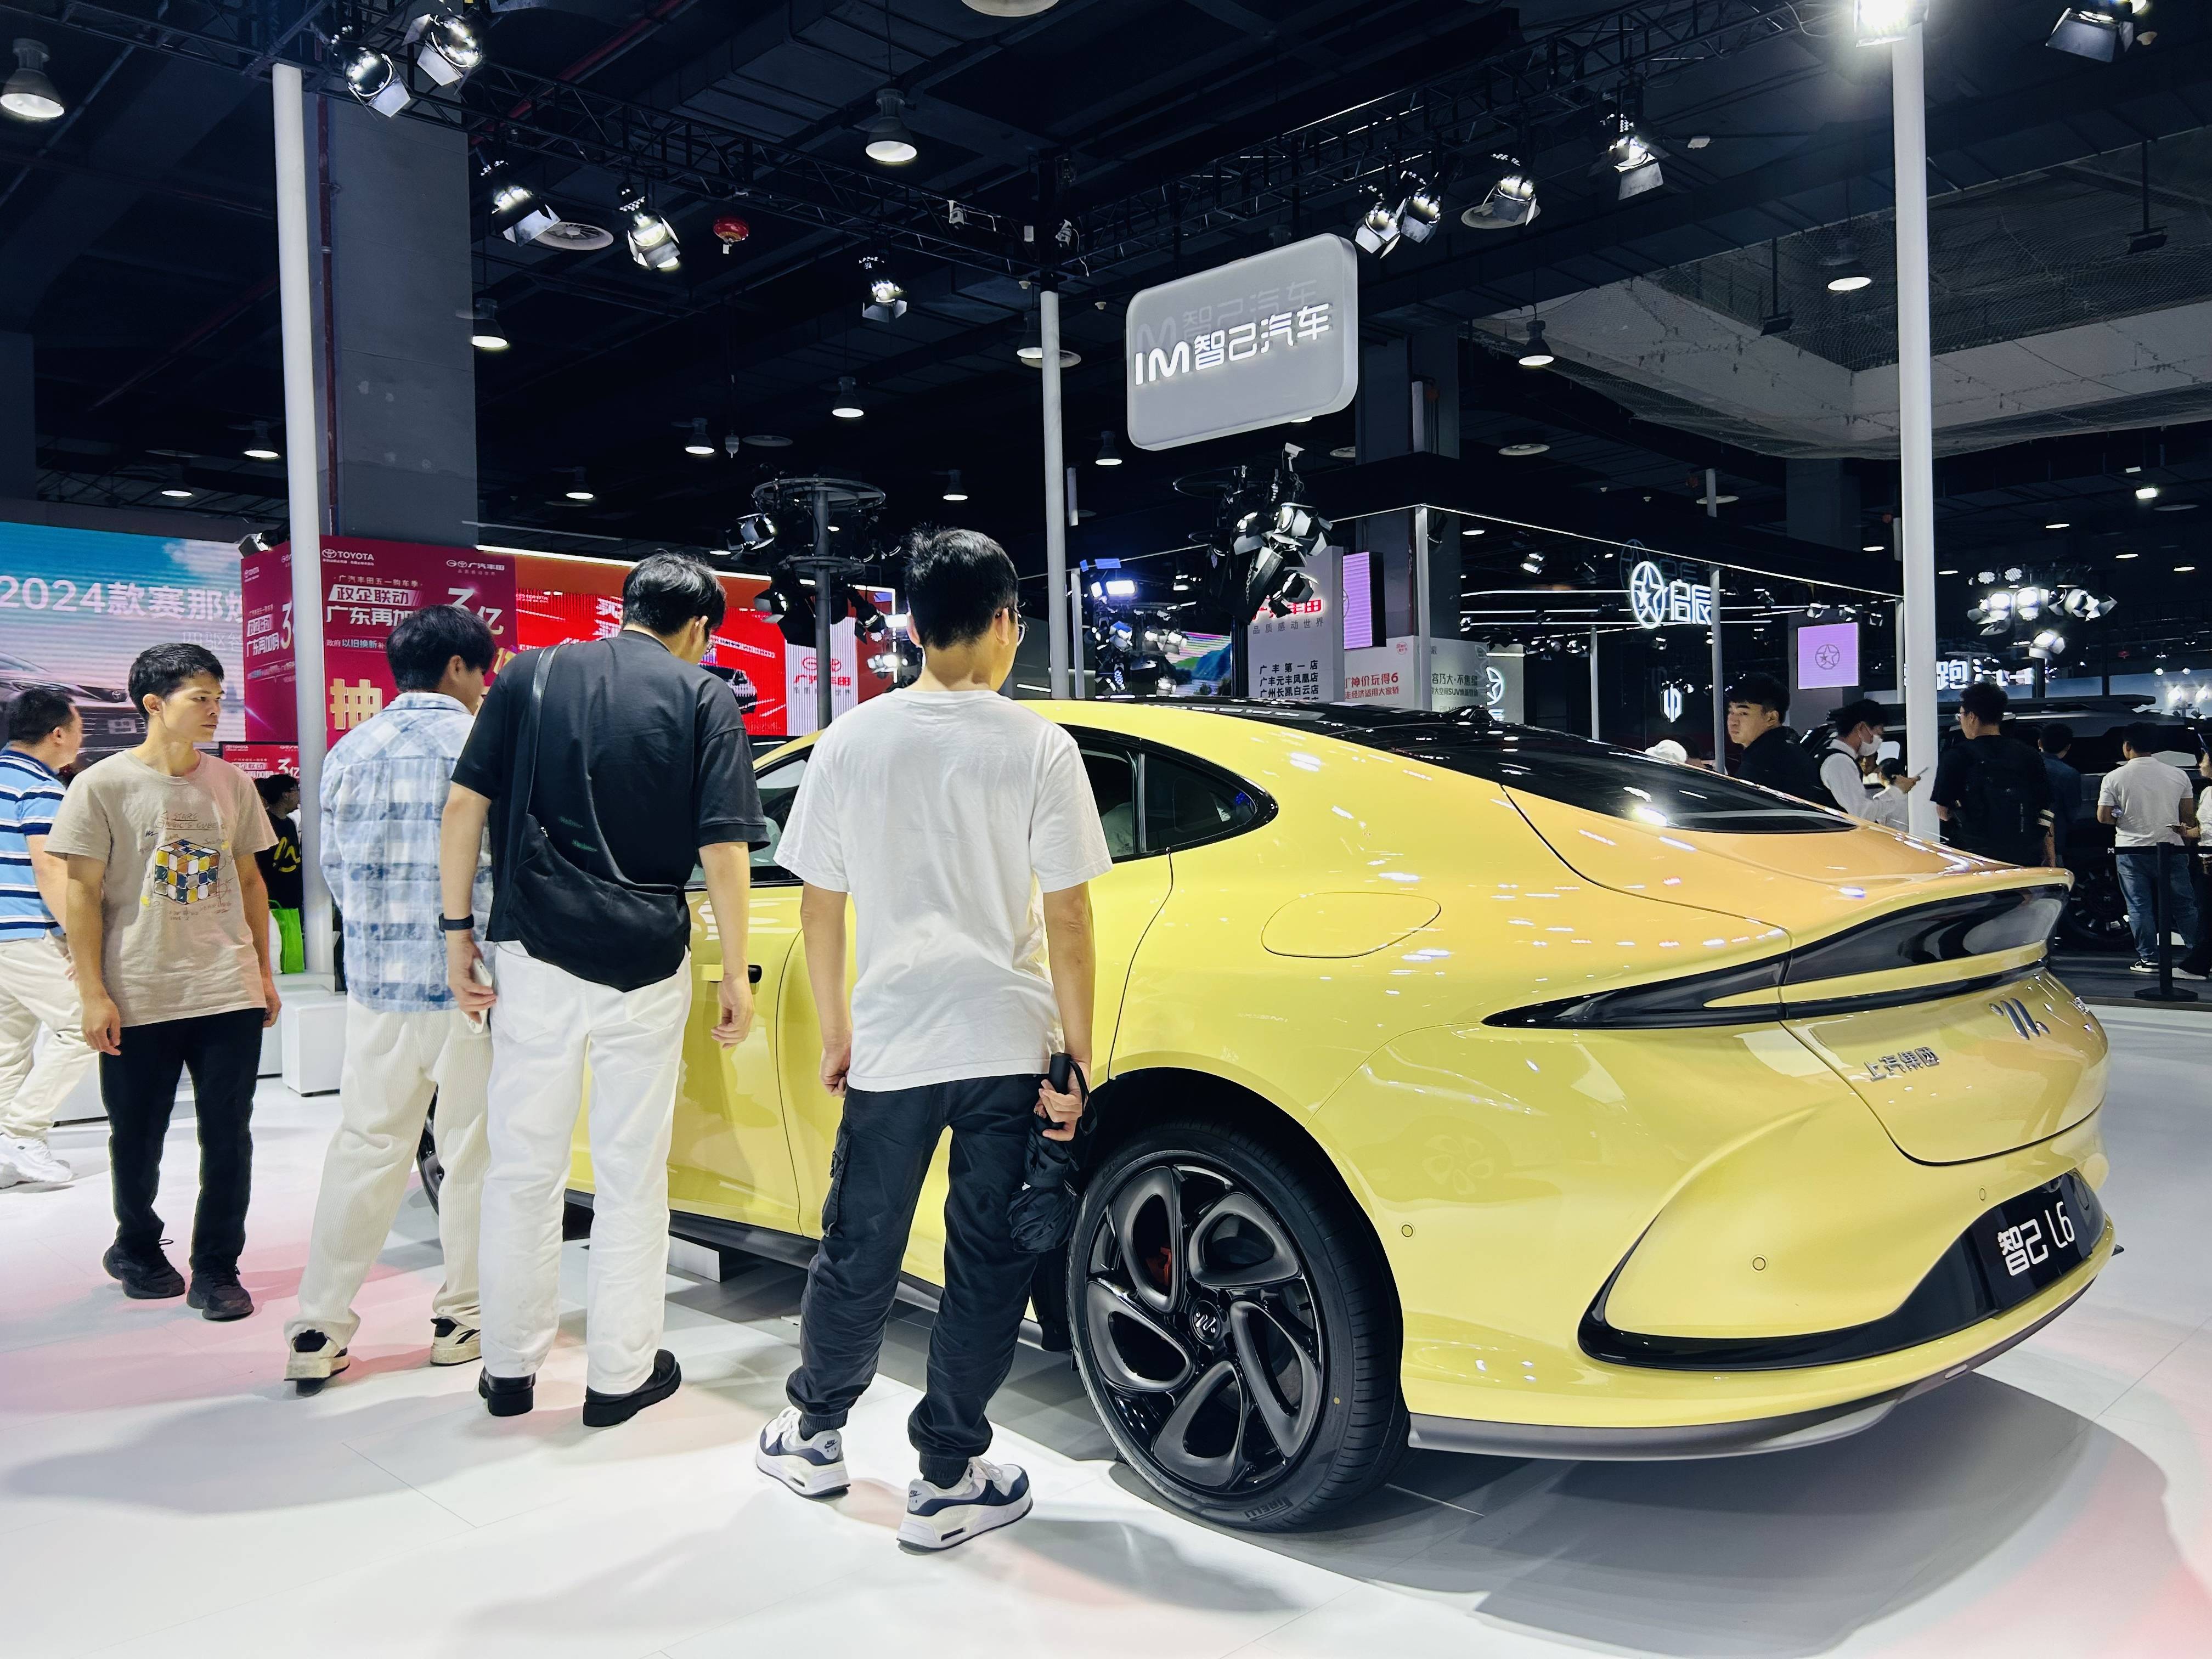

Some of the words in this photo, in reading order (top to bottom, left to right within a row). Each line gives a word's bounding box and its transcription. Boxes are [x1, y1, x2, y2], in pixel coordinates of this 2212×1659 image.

[337, 550, 374, 561] TOYOTA
[337, 586, 409, 605] 政企联动
[1252, 617, 1324, 635] 品质感动世界
[330, 678, 383, 730] 抽
[1864, 1046, 1940, 1082] 上汽集团
[1997, 1218, 2049, 1276] 智己
